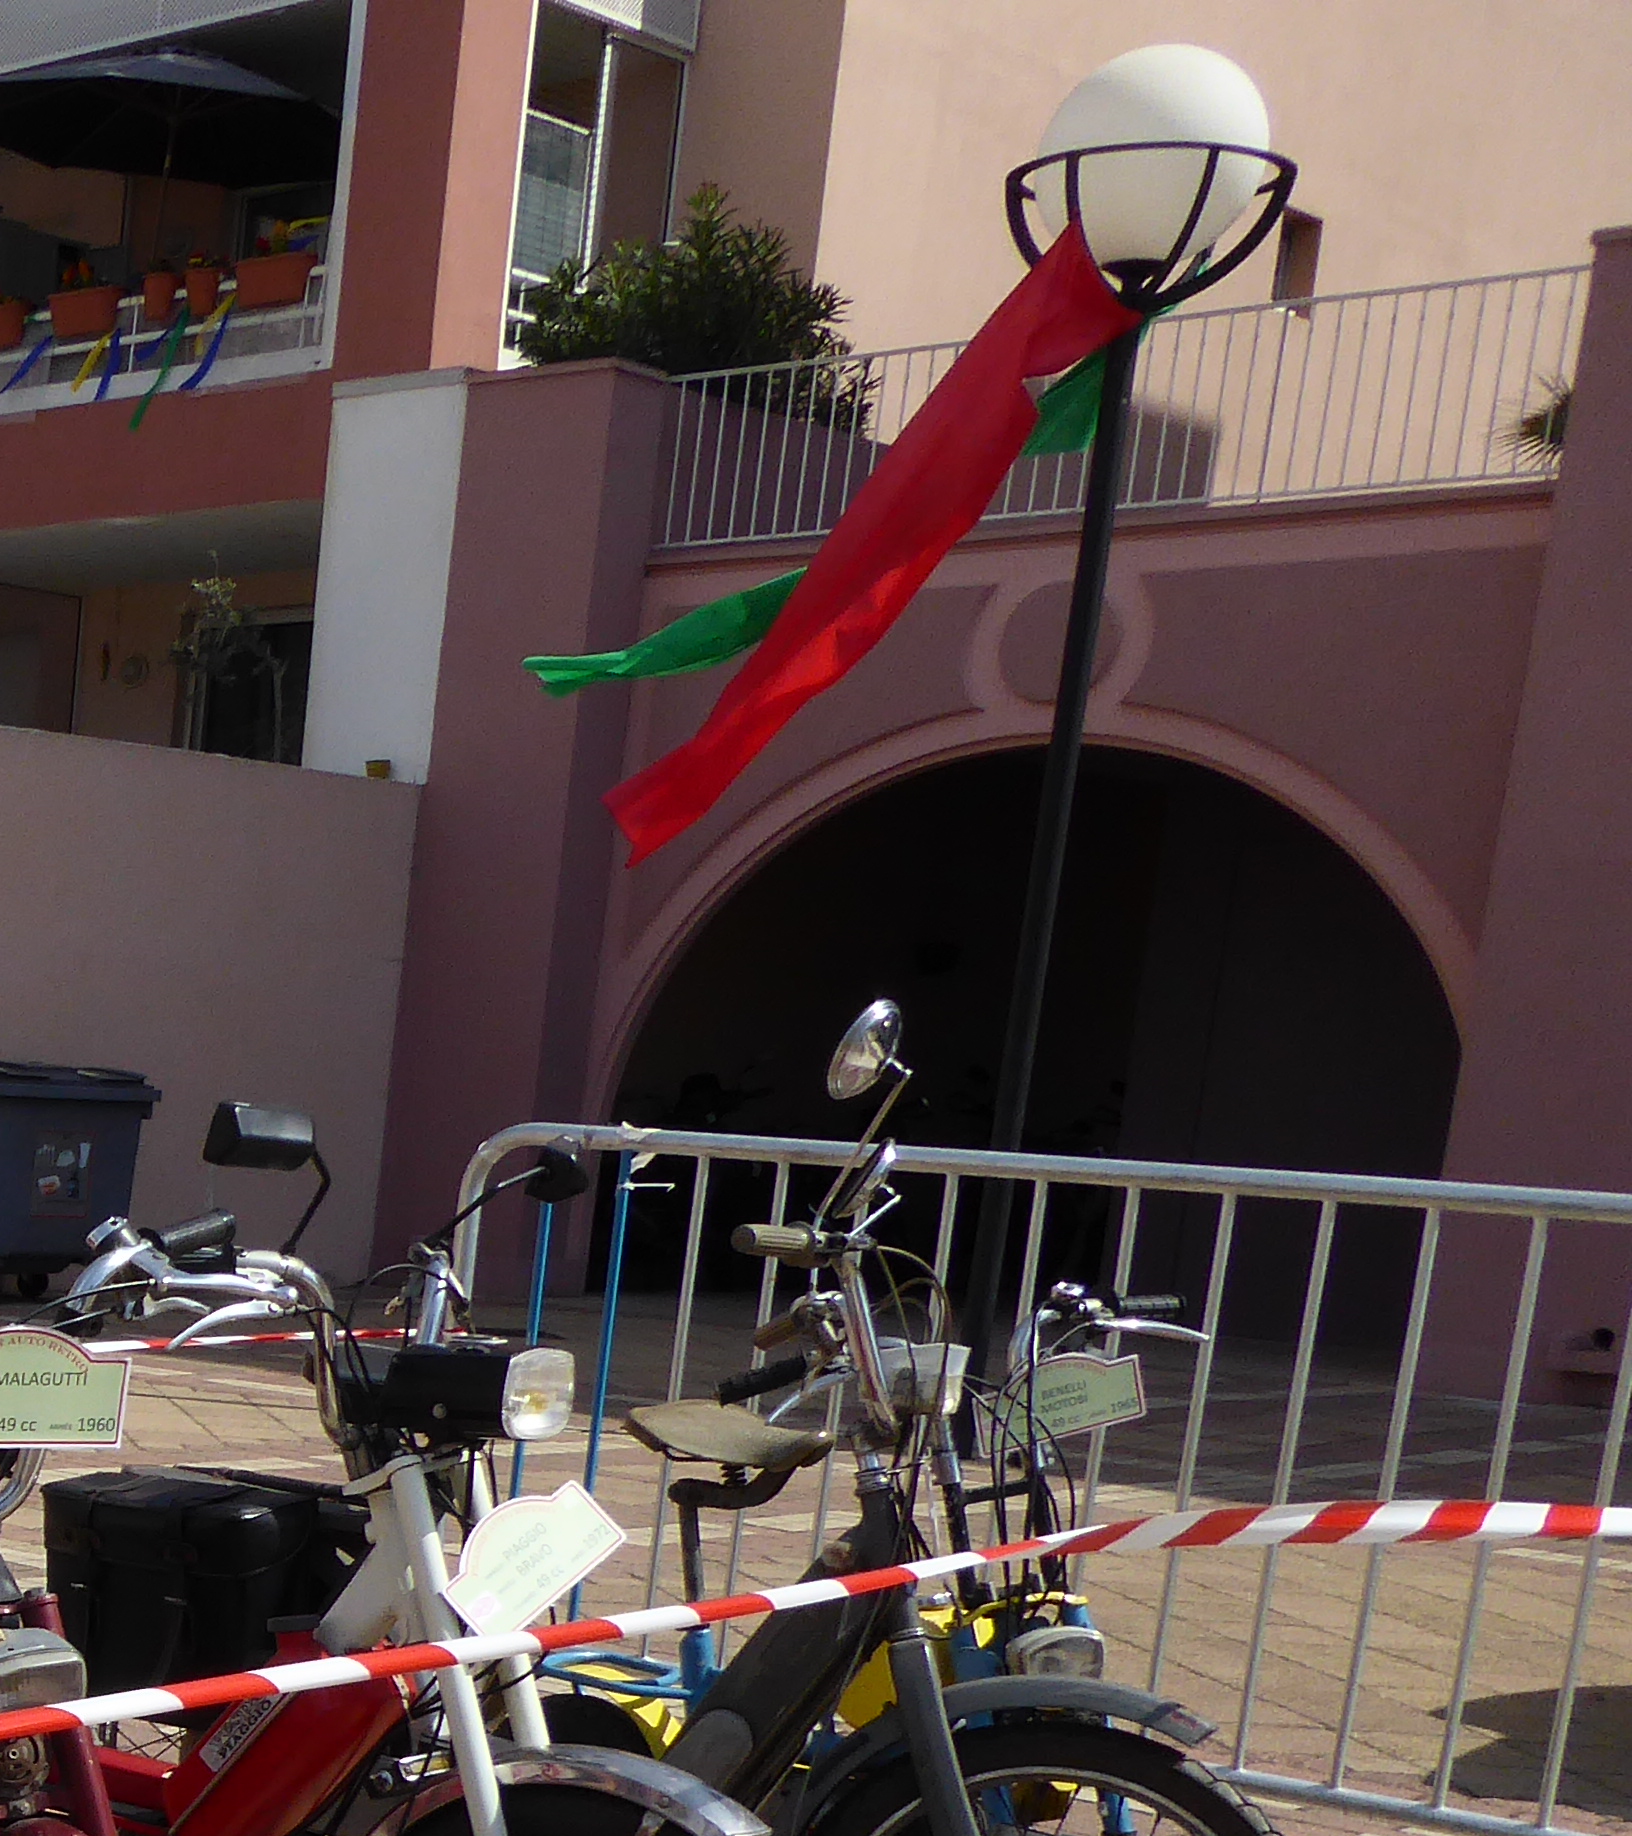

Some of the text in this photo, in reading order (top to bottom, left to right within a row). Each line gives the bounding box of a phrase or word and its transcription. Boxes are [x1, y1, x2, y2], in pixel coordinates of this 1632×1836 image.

[8, 1335, 46, 1346] AUTO
[48, 1340, 89, 1373] RETRO
[20, 1420, 37, 1432] cc
[77, 1417, 115, 1432] 1960
[502, 1522, 547, 1561] PIAGGIO
[515, 1544, 553, 1577] BRAVO
[536, 1573, 551, 1589] 49
[584, 1523, 612, 1550] 1972
[217, 1699, 272, 1759] PIAGGIO
